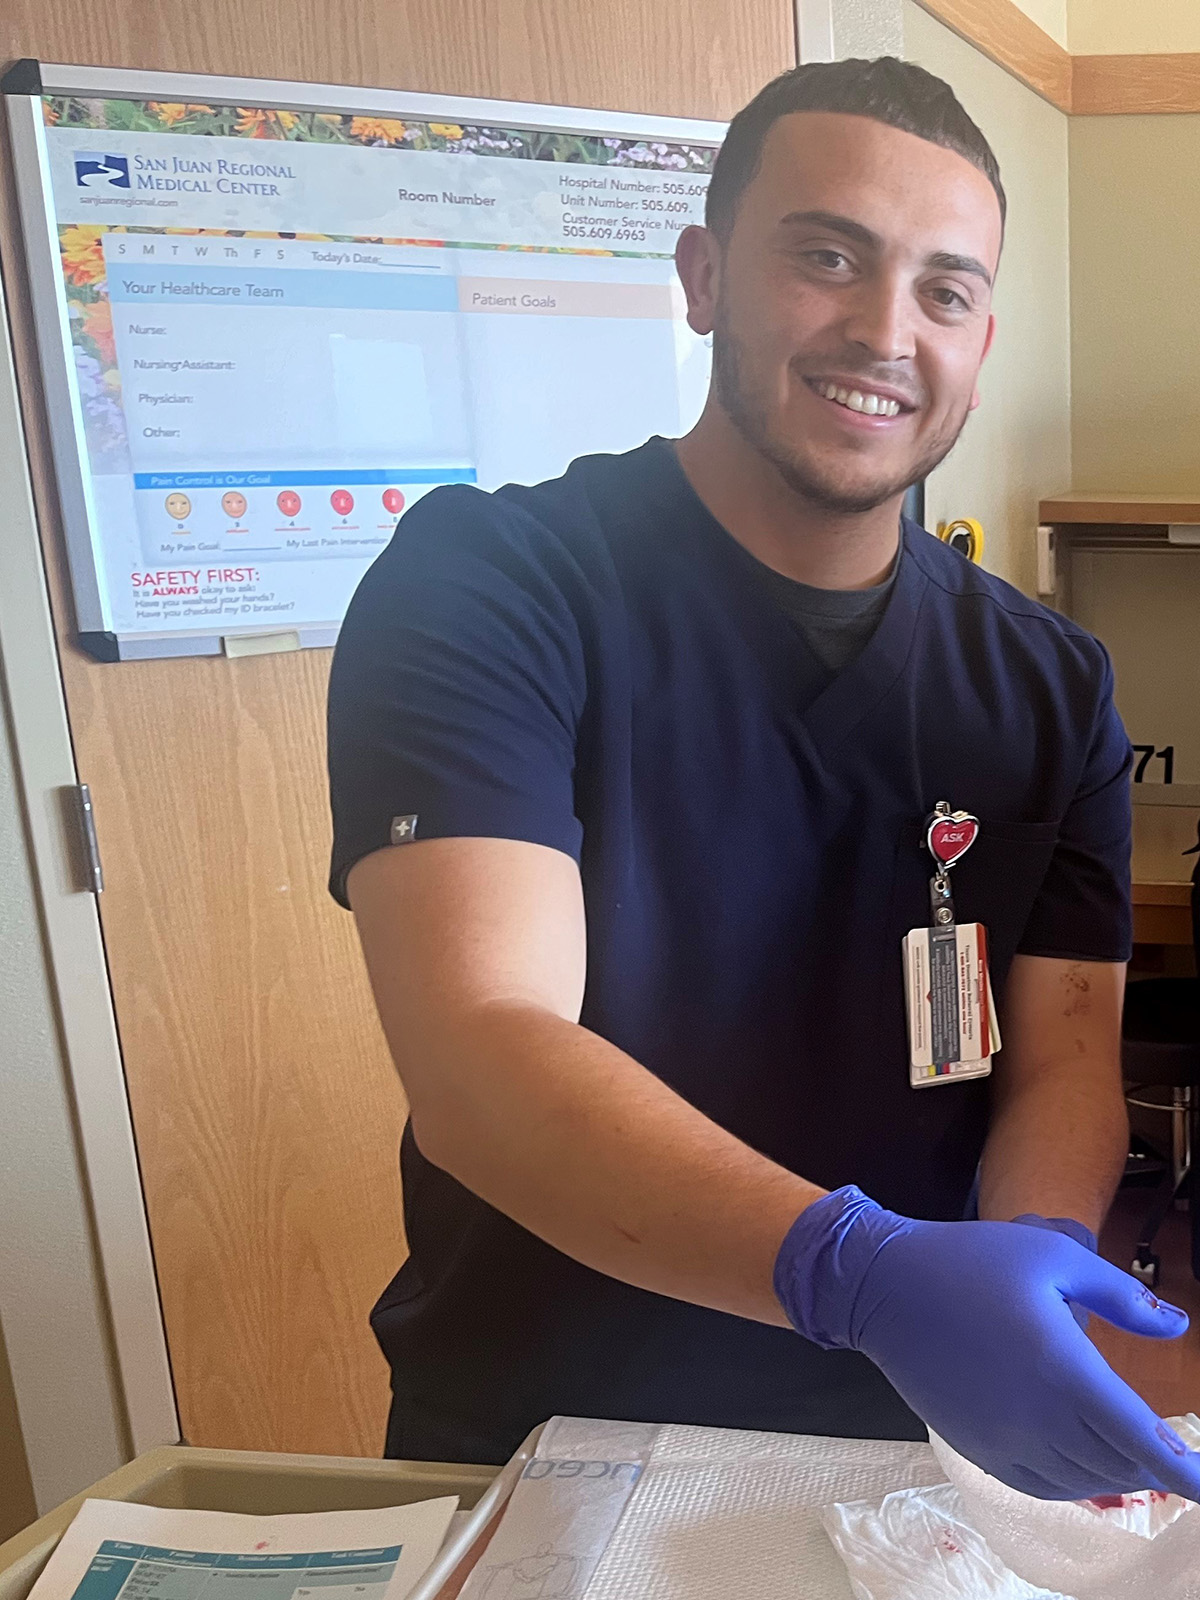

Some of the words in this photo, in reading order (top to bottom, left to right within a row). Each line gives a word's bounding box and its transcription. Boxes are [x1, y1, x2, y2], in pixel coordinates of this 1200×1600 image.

[134, 155, 167, 171] SAN
[173, 157, 212, 174] JUAN
[217, 159, 296, 179] REGIONAL
[137, 174, 211, 192] MEDICAL
[217, 178, 280, 196] CENTER
[559, 175, 606, 190] Hospital
[610, 179, 660, 193] Number:
[79, 196, 178, 208] sanjuanregional.com
[398, 188, 438, 203] Room
[441, 192, 496, 207] Number
[561, 194, 585, 206] Unit
[588, 196, 638, 210] Number:
[562, 212, 618, 226] Customer
[622, 217, 661, 229] Service
[562, 226, 646, 241] 505.609.6963
[118, 244, 126, 254] S
[142, 245, 155, 256] M
[171, 245, 178, 256] T
[194, 247, 208, 257] W
[224, 247, 238, 258] Th
[254, 249, 261, 259] F
[277, 249, 285, 260] S
[311, 251, 350, 265] Today's
[122, 280, 156, 295] Your
[160, 282, 241, 297] Healthcare
[245, 284, 284, 298] Team
[472, 293, 517, 306] Patient
[520, 295, 556, 308] Goals
[129, 324, 167, 335] Nurse:
[138, 393, 193, 405] Physician:
[143, 427, 181, 438] Other:
[150, 477, 172, 486] Pain
[175, 475, 214, 485] Control
[225, 475, 245, 484] Our
[247, 474, 271, 484] Goal
[130, 569, 201, 587] SAFETY
[207, 568, 260, 583] FIRST:
[152, 586, 199, 596] ALWAYS
[226, 585, 236, 593] to
[135, 599, 160, 608] Have
[162, 600, 180, 609] you
[219, 597, 240, 607] your
[242, 593, 275, 602] hands?
[136, 610, 161, 618] Have
[164, 610, 181, 619] you
[183, 607, 222, 616] checked
[224, 606, 239, 615] my
[240, 604, 251, 613] ID
[253, 602, 295, 613] bracelet?
[940, 832, 965, 843] ASK
